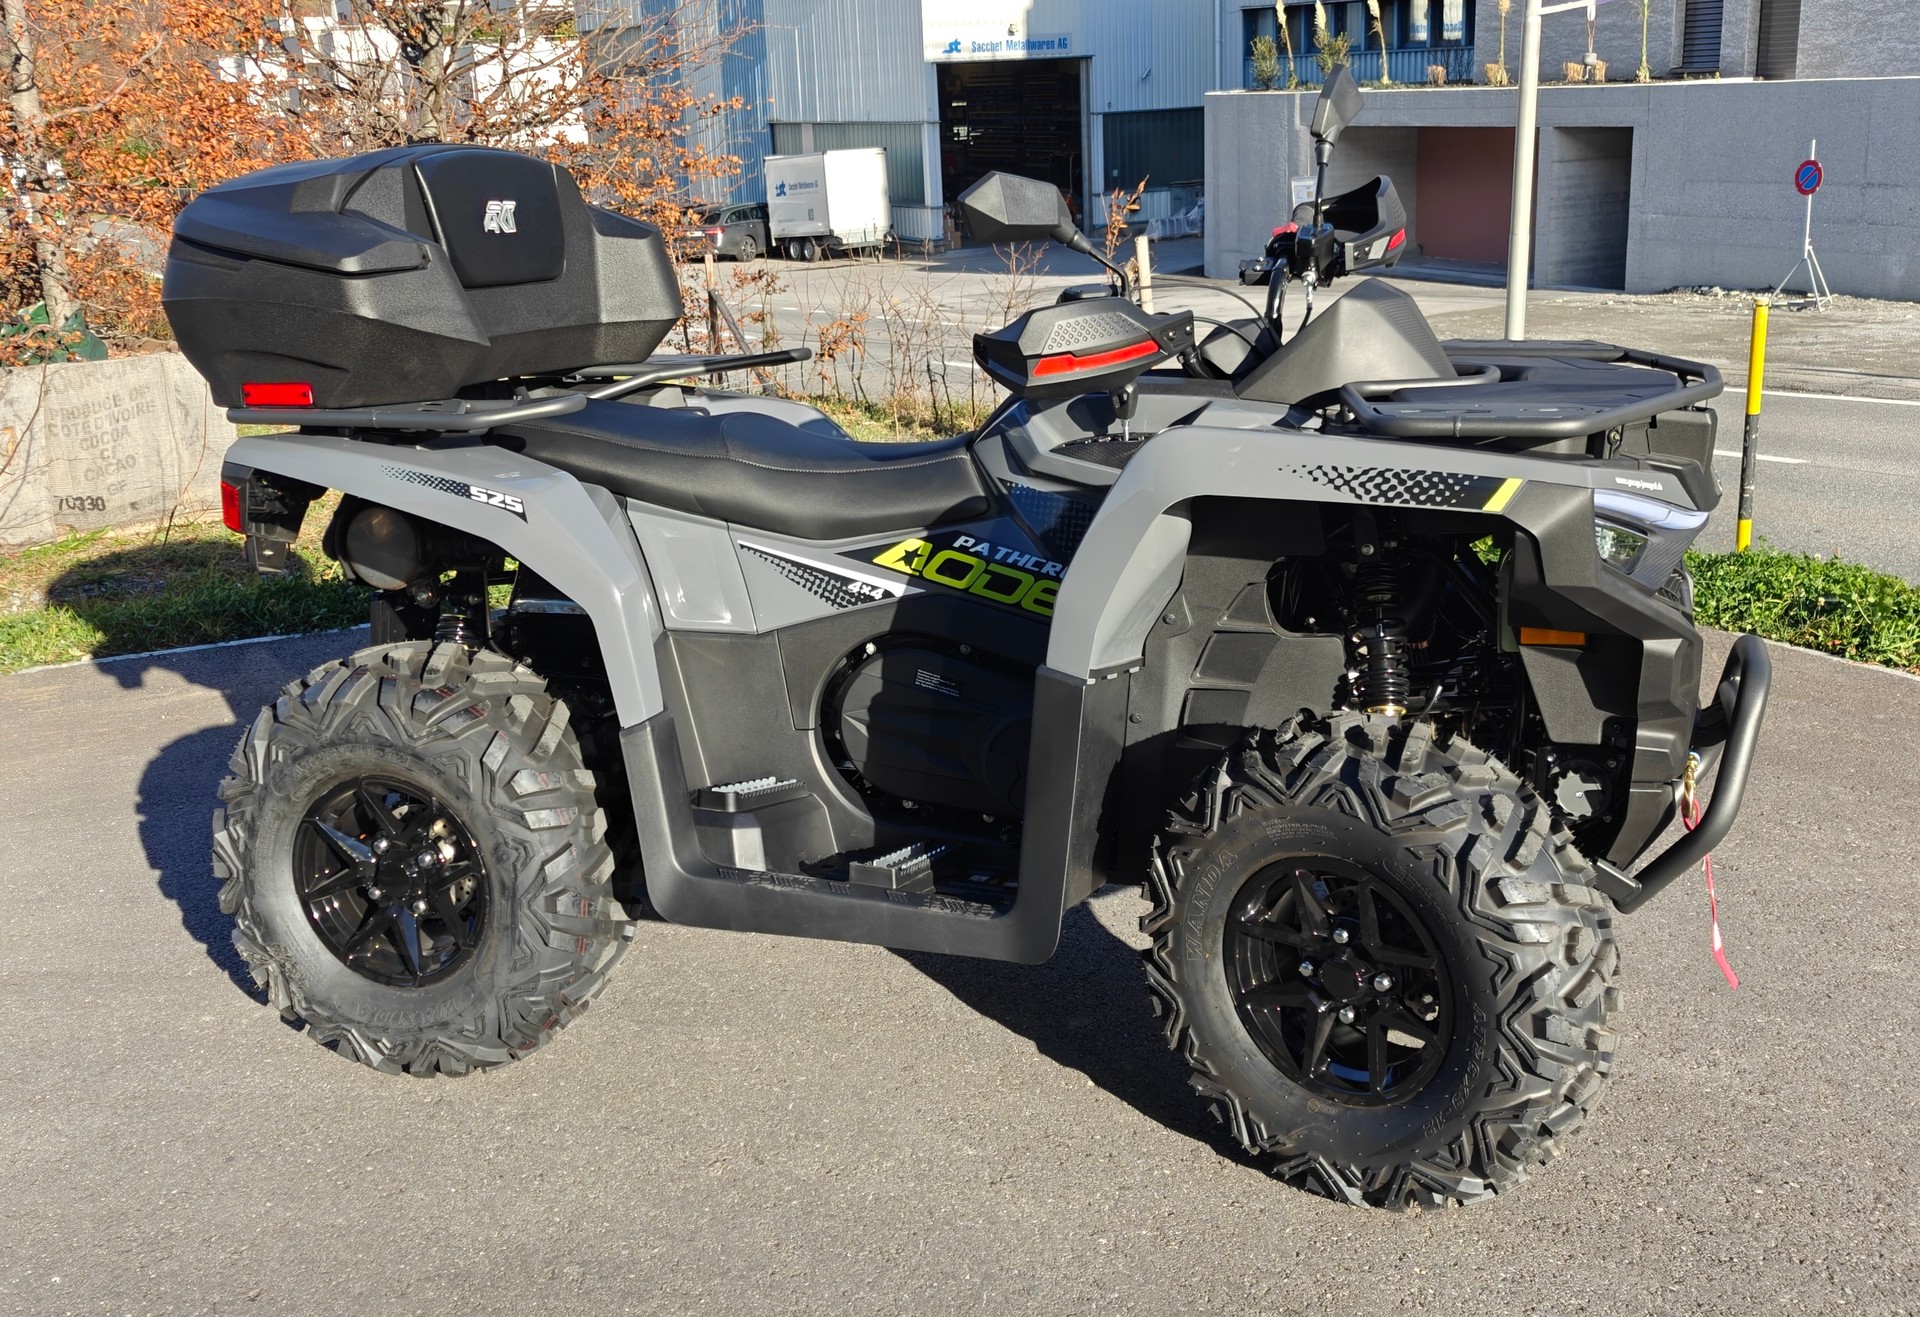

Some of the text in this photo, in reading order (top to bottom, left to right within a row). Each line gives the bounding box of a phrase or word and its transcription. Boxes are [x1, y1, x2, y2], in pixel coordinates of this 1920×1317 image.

[971, 37, 1068, 53] Sacchet Metallwaren AG
[50, 393, 123, 420] PRODUCE
[79, 425, 131, 451] COCOA
[53, 495, 107, 512] 70330
[469, 485, 524, 513] 525
[952, 535, 1069, 580] PATHCR
[847, 581, 885, 600] 4x4
[1186, 848, 1238, 962] WANDA
